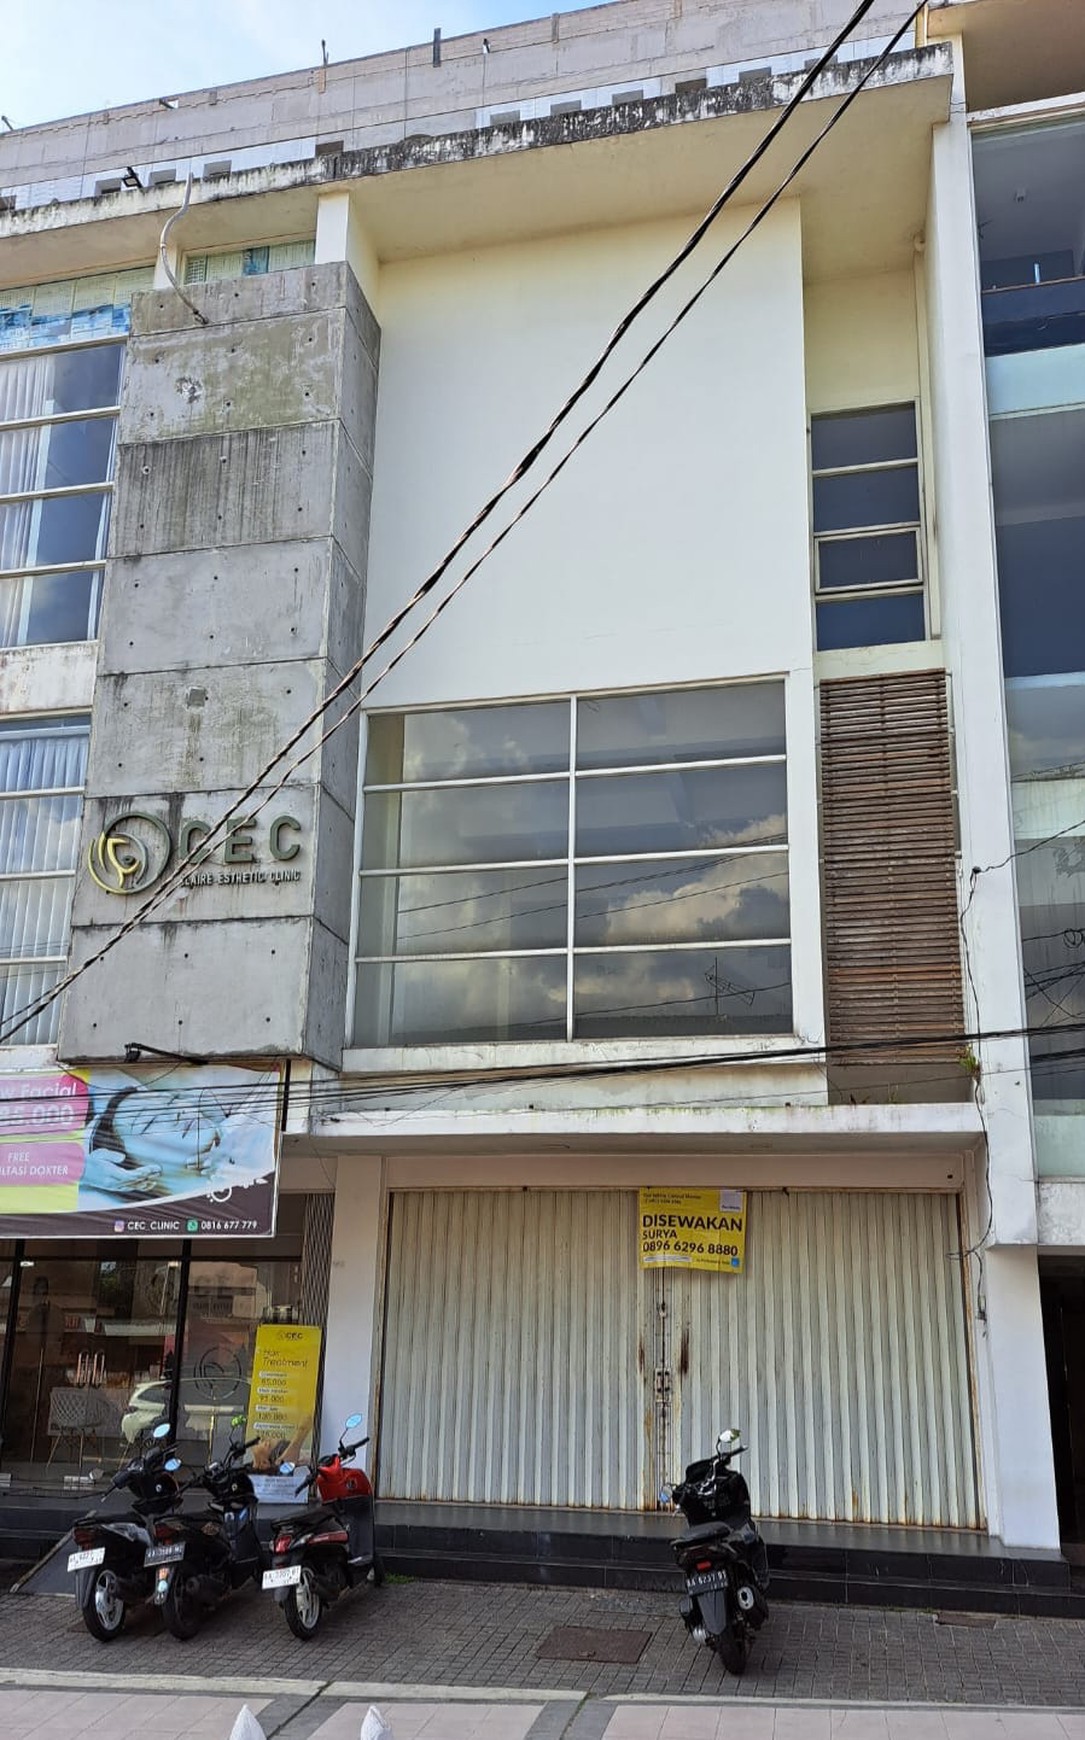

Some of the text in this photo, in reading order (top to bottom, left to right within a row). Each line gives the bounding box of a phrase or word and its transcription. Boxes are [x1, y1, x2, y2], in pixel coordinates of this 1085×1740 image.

[179, 814, 302, 865] CEC
[181, 867, 301, 887] LAIRE ESTHETIC CLINIC
[20, 1082, 77, 1099] Facial
[8, 1152, 30, 1162] FREE
[201, 1219, 220, 1231] 0816
[642, 1214, 743, 1232] DISEWAKAN
[642, 1229, 678, 1240] SURYA
[642, 1241, 738, 1257] 0896 6296 8880
